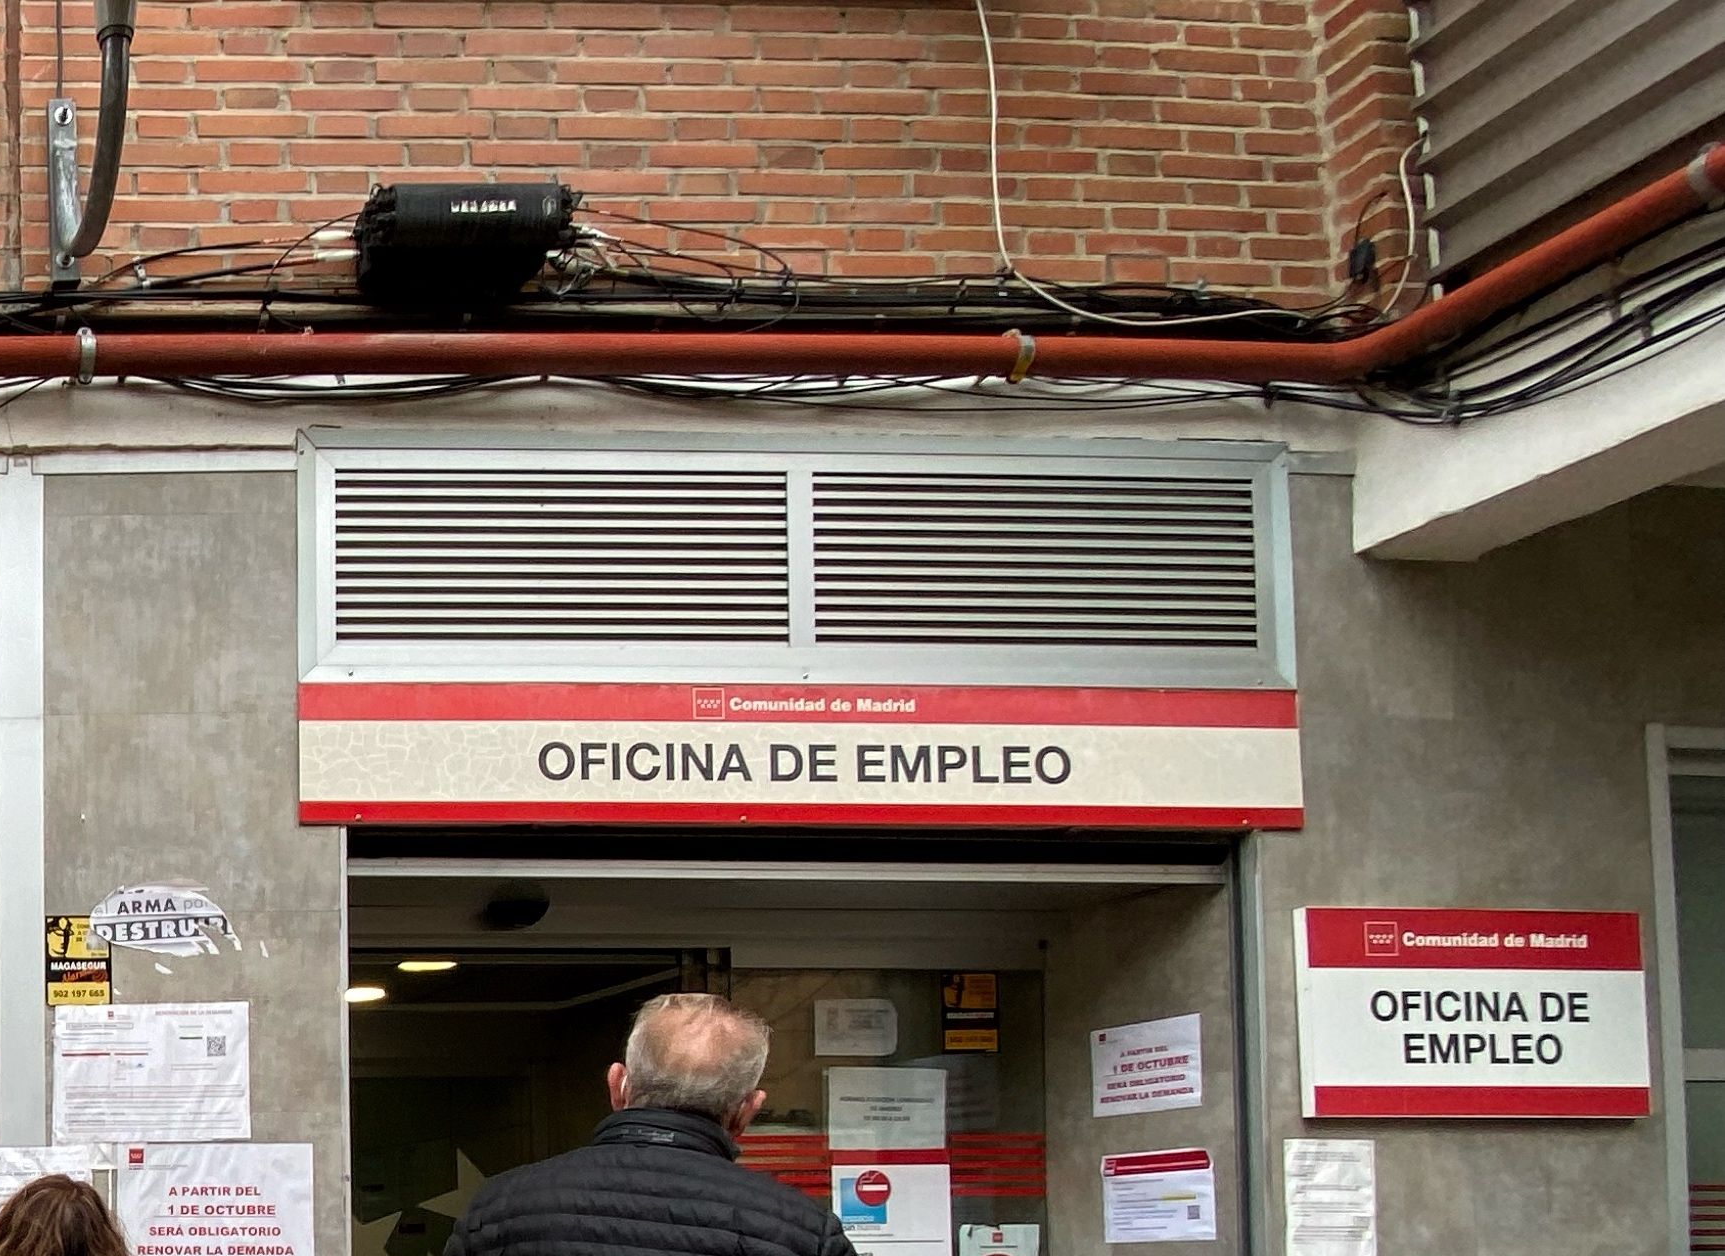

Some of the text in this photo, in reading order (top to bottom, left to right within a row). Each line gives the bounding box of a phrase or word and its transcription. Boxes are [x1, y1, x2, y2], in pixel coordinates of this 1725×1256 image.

[729, 697, 915, 713] Comunidad de Madrid
[538, 741, 1072, 785] OFICINA DE EMPLEO
[117, 898, 177, 915] ARMA
[1402, 931, 1588, 948] Comunidad de Madrid
[50, 961, 107, 970] MAGASEGUR
[53, 989, 69, 998] 902
[72, 989, 87, 998] 197
[1370, 990, 1590, 1023] OFICINA DE
[1403, 1033, 1563, 1065] EMPLEO
[1120, 1063, 1134, 1073] DE
[1137, 1055, 1189, 1070] OCTUBRE
[168, 1186, 261, 1196] A PARTIR DEL
[167, 1205, 276, 1215] 1 DE OCTUBRE
[149, 1225, 282, 1236] SERÁ OBLIGATORIO
[137, 1246, 294, 1255] RENOVAR LA DEMANDA
